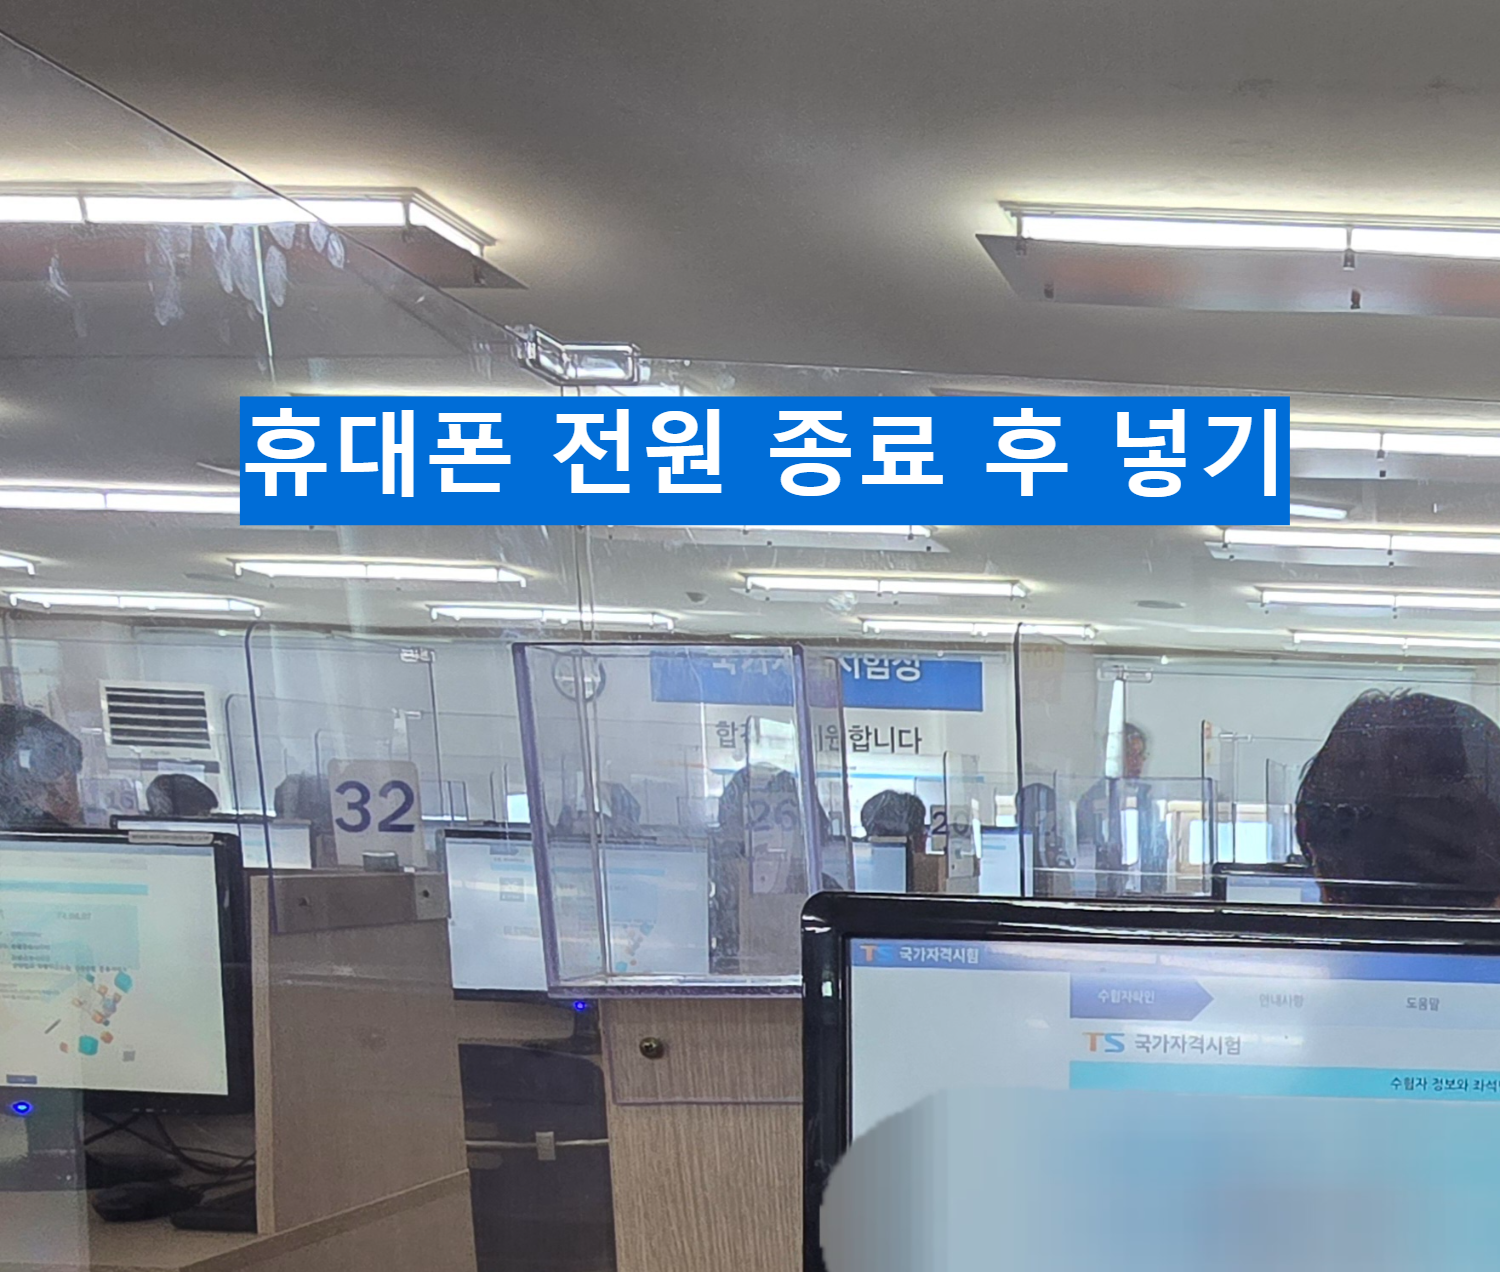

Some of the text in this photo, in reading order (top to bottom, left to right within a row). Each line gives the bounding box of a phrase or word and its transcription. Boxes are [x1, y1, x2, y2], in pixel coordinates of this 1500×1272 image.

[335, 779, 415, 833] 32
[899, 946, 979, 964] 국가자격시험
[1083, 1031, 1241, 1056] TS 국가자격시험
[1390, 1076, 1428, 1091] 수험자
[1432, 1077, 1469, 1093] 정보와
